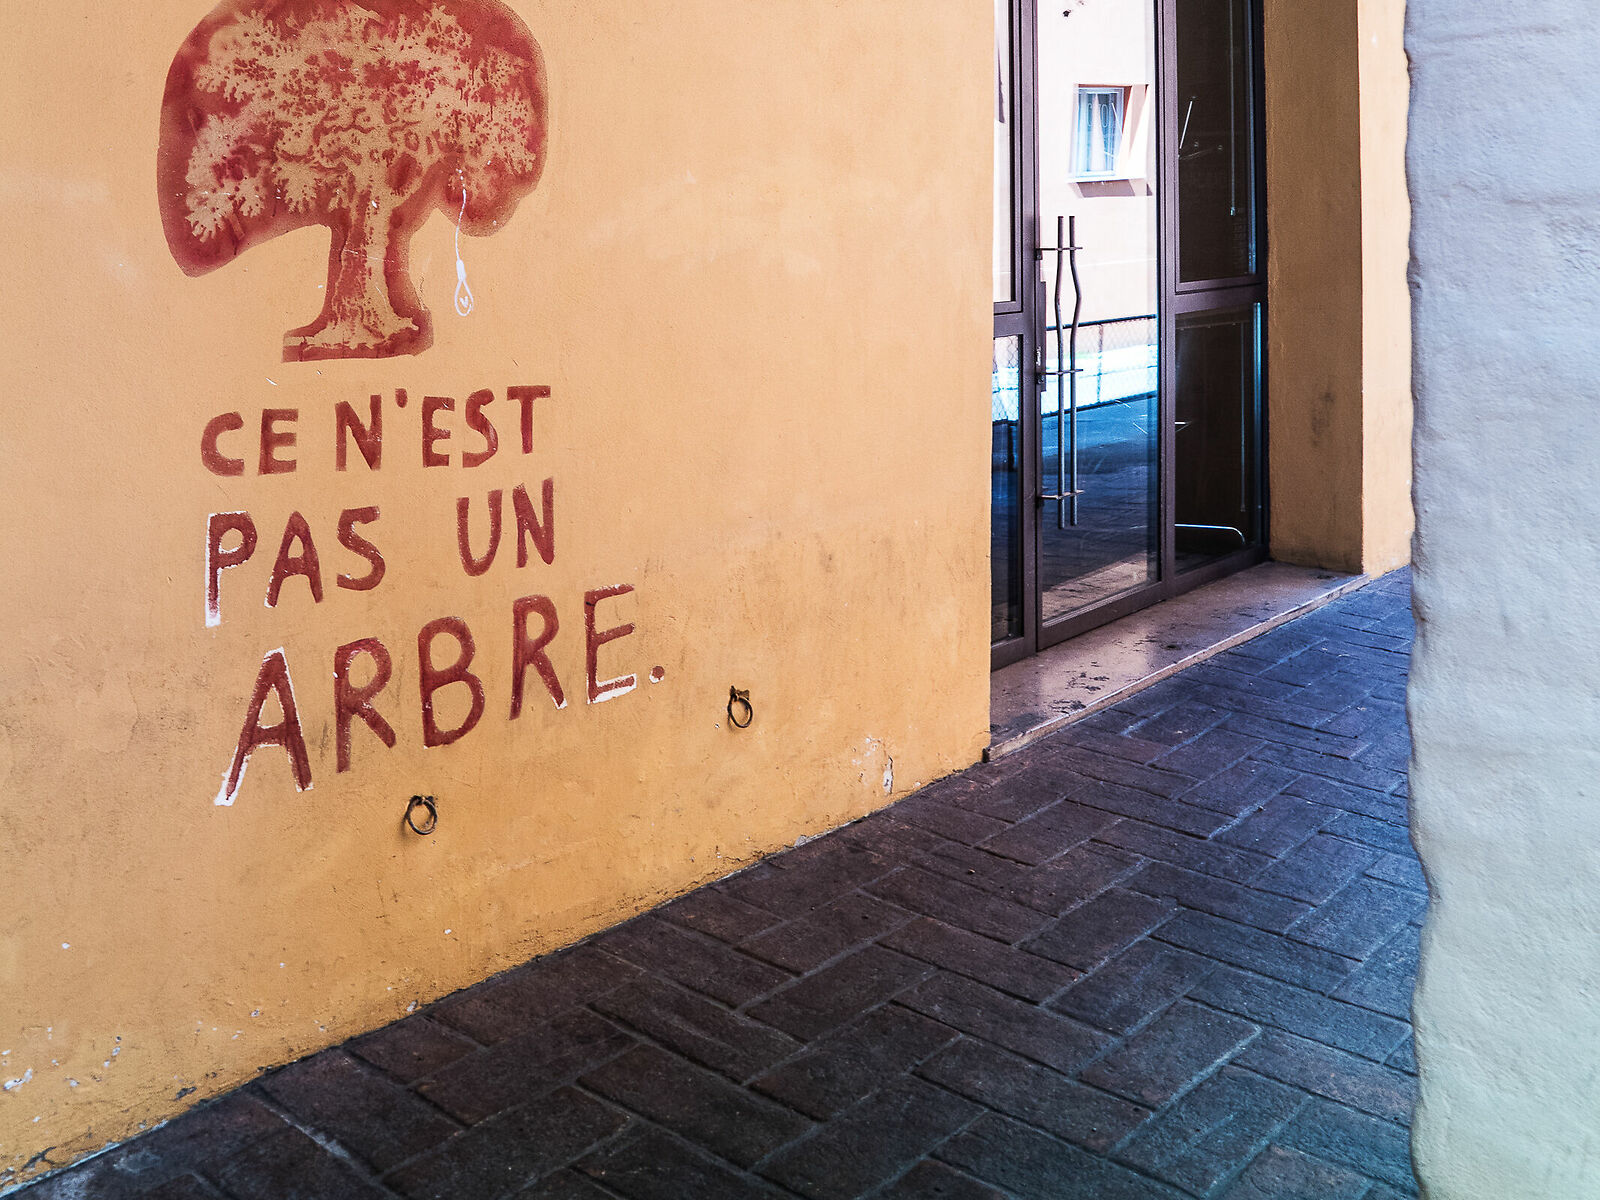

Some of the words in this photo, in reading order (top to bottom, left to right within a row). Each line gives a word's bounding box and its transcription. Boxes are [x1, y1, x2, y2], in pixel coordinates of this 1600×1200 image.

[200, 408, 299, 477] CE
[335, 385, 551, 472] N'EST
[205, 506, 387, 627] PAS
[456, 477, 556, 577] UN
[214, 583, 665, 805] ARBRE.
